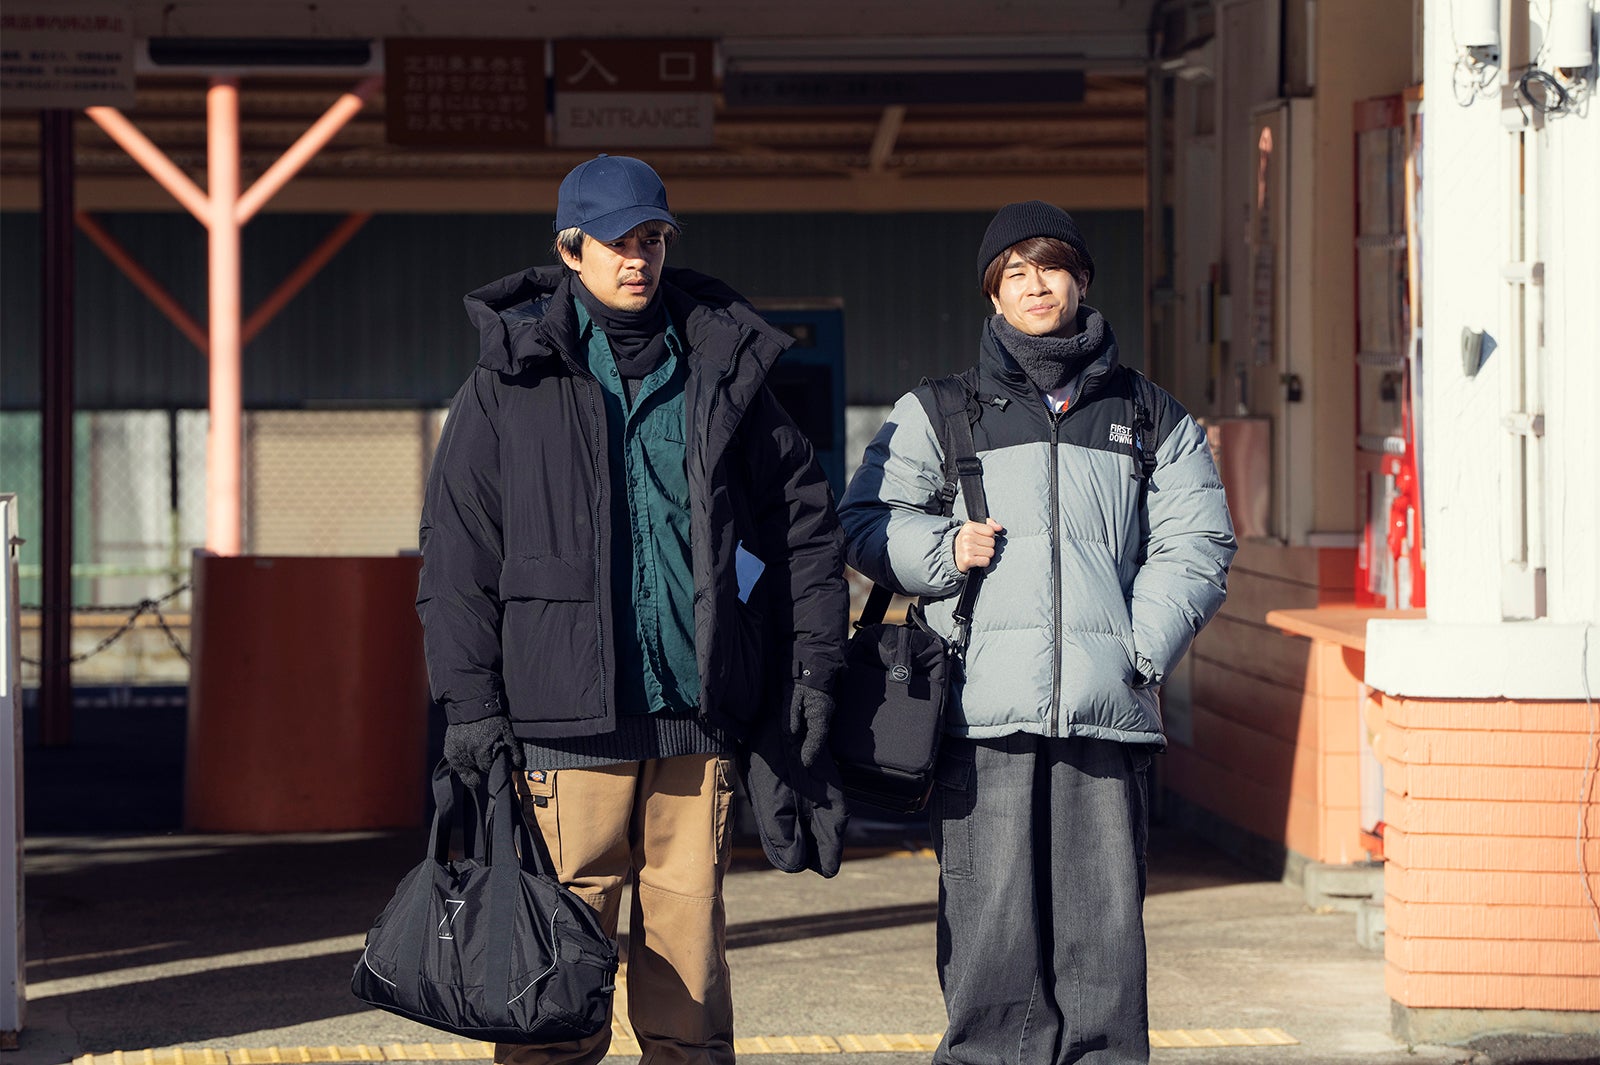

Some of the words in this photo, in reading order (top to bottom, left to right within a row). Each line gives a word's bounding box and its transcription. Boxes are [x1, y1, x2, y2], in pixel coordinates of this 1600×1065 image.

[567, 48, 696, 84] 入口
[570, 107, 701, 129] ENTRANCE
[1110, 423, 1132, 435] FIRST
[1109, 433, 1131, 444] DOWN
